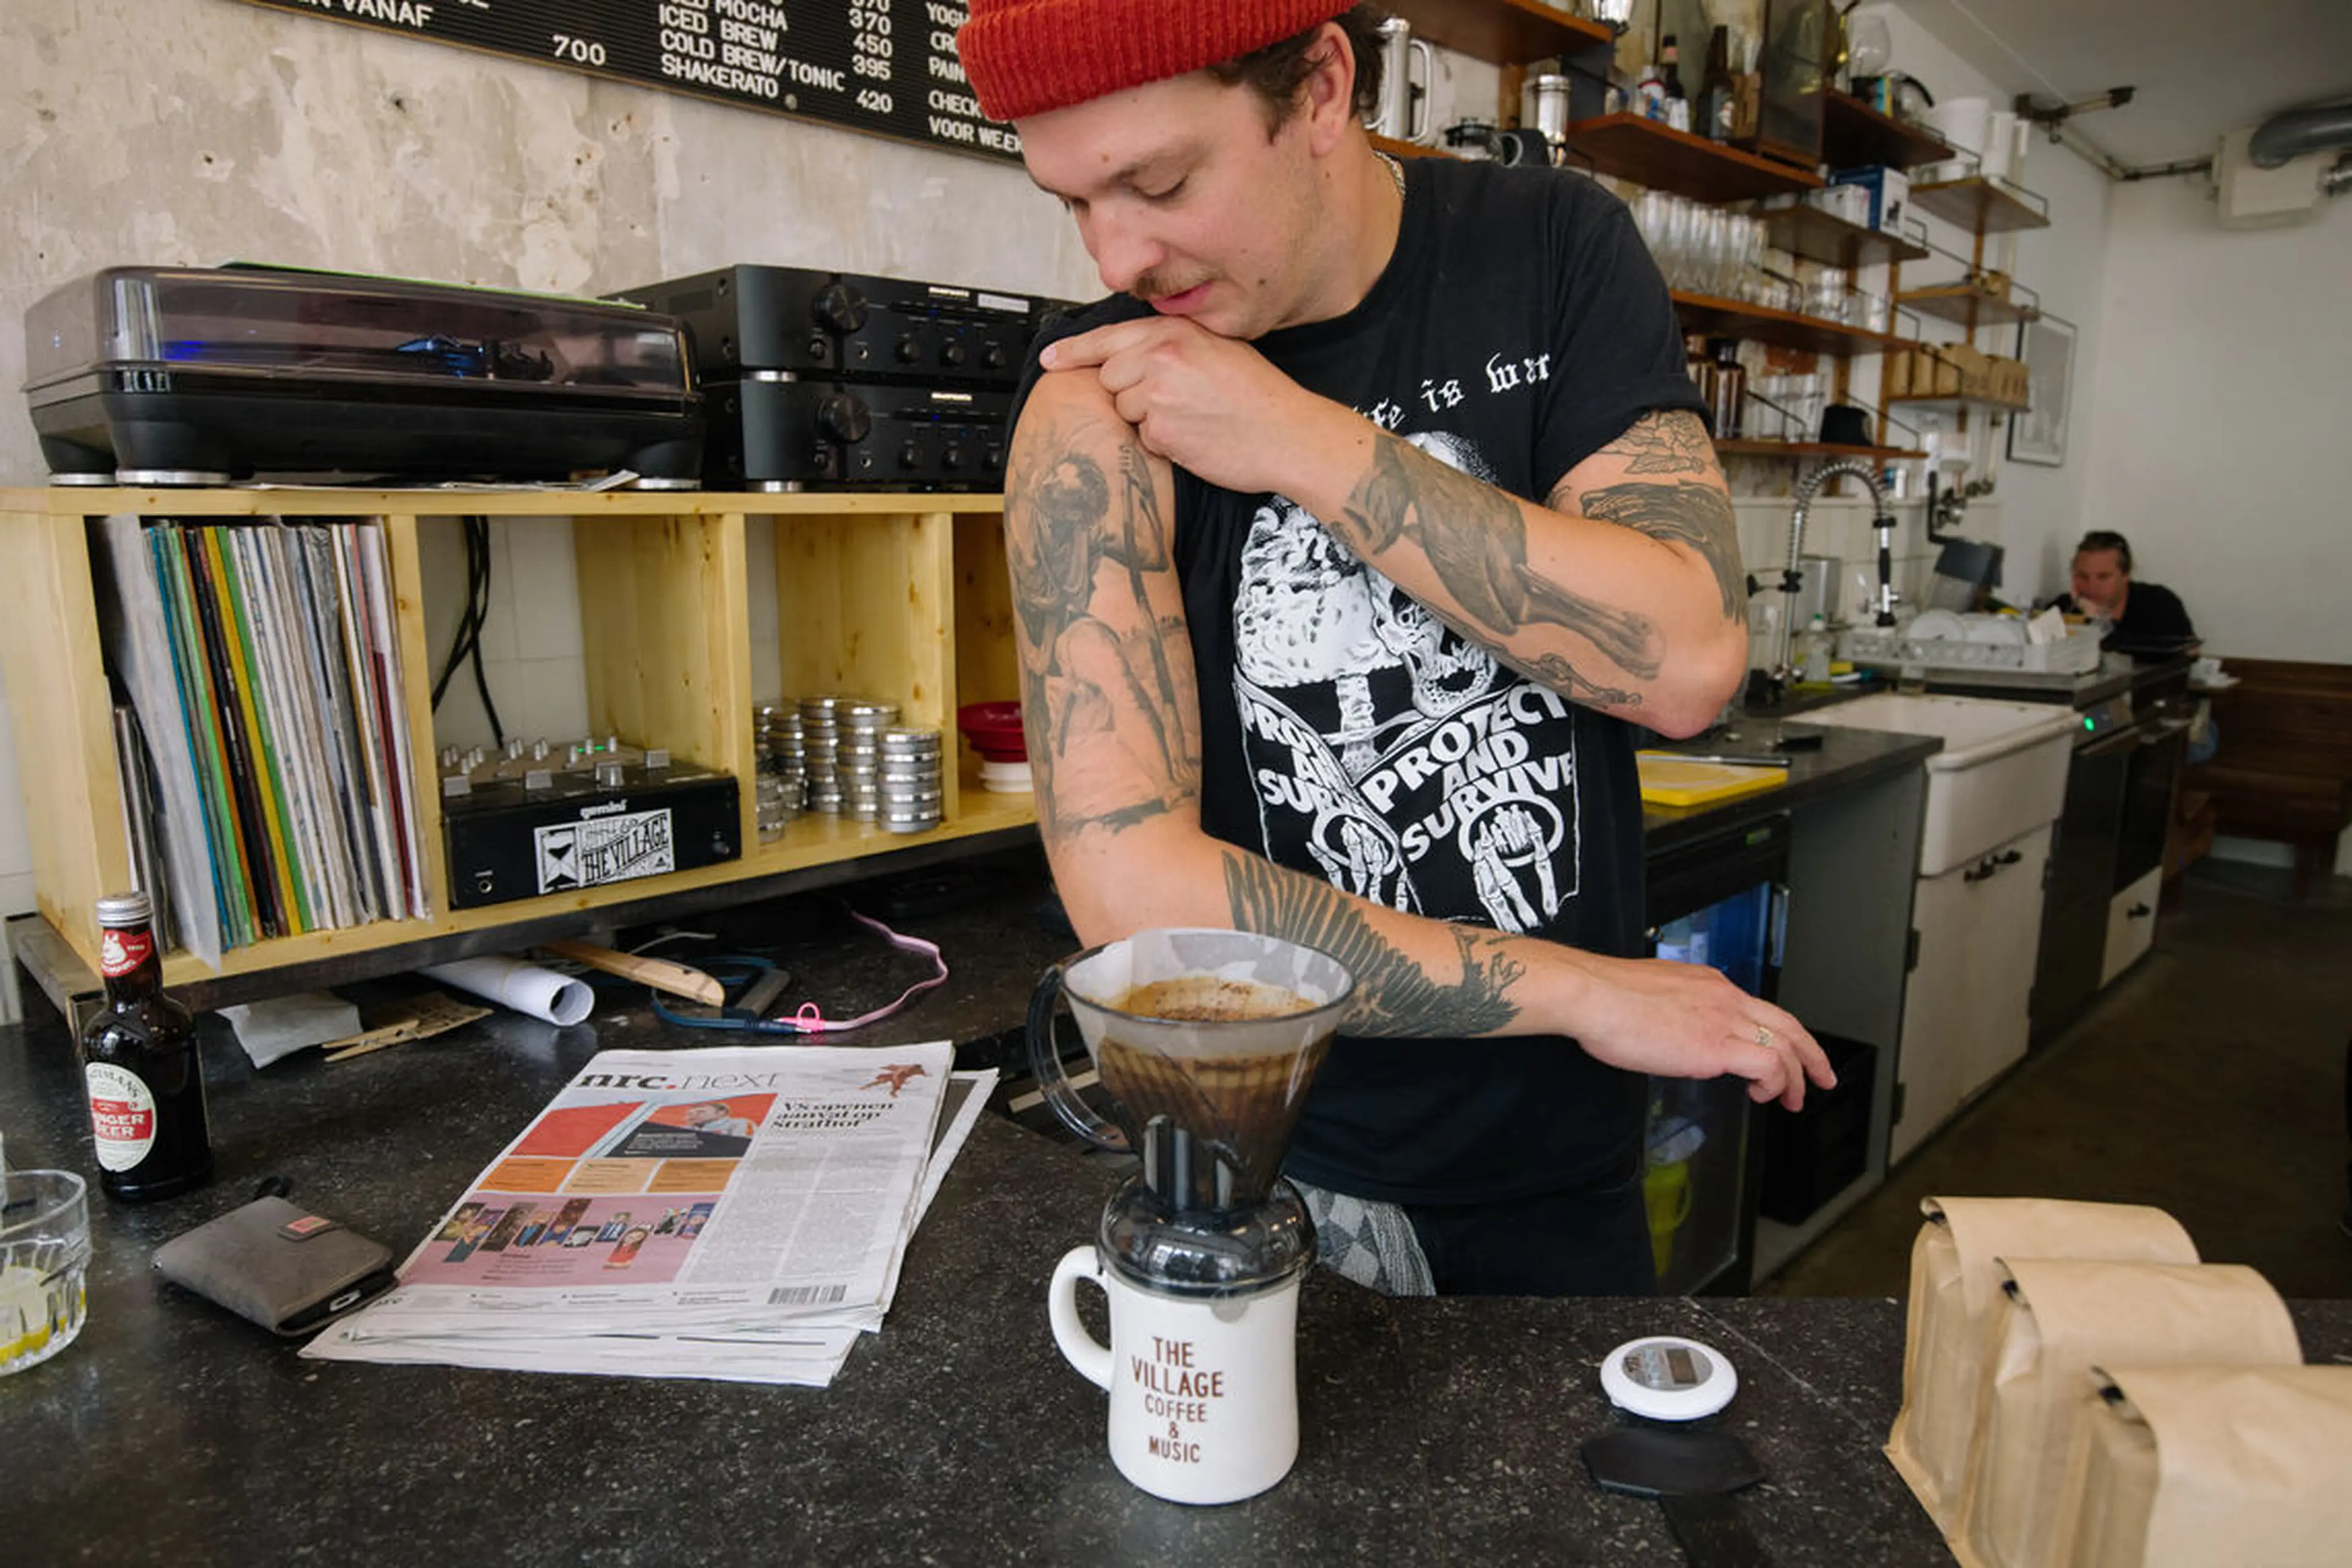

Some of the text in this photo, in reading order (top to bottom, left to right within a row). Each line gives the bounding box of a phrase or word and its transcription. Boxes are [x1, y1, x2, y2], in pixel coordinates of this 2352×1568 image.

[660, 4, 777, 51] ICED BREW
[849, 8, 892, 35] 370
[552, 35, 606, 66] 700
[660, 29, 845, 92] COLD BREW/TONIC
[853, 32, 893, 58] 450
[662, 53, 778, 99] SHAKERATO
[852, 54, 891, 81] 395
[856, 89, 893, 113] 420
[928, 115, 974, 143] VOOR
[1360, 683, 1568, 814] PROTECT
[1442, 730, 1529, 801] AND
[1402, 752, 1573, 862] SURVIVE
[609, 812, 669, 871] VILLAGE
[1152, 1336, 1195, 1368] THE
[1131, 1354, 1224, 1398] VILLAGE
[1144, 1393, 1207, 1423] COFFEE
[1168, 1420, 1179, 1439] &
[1148, 1436, 1201, 1463] MUSIC
